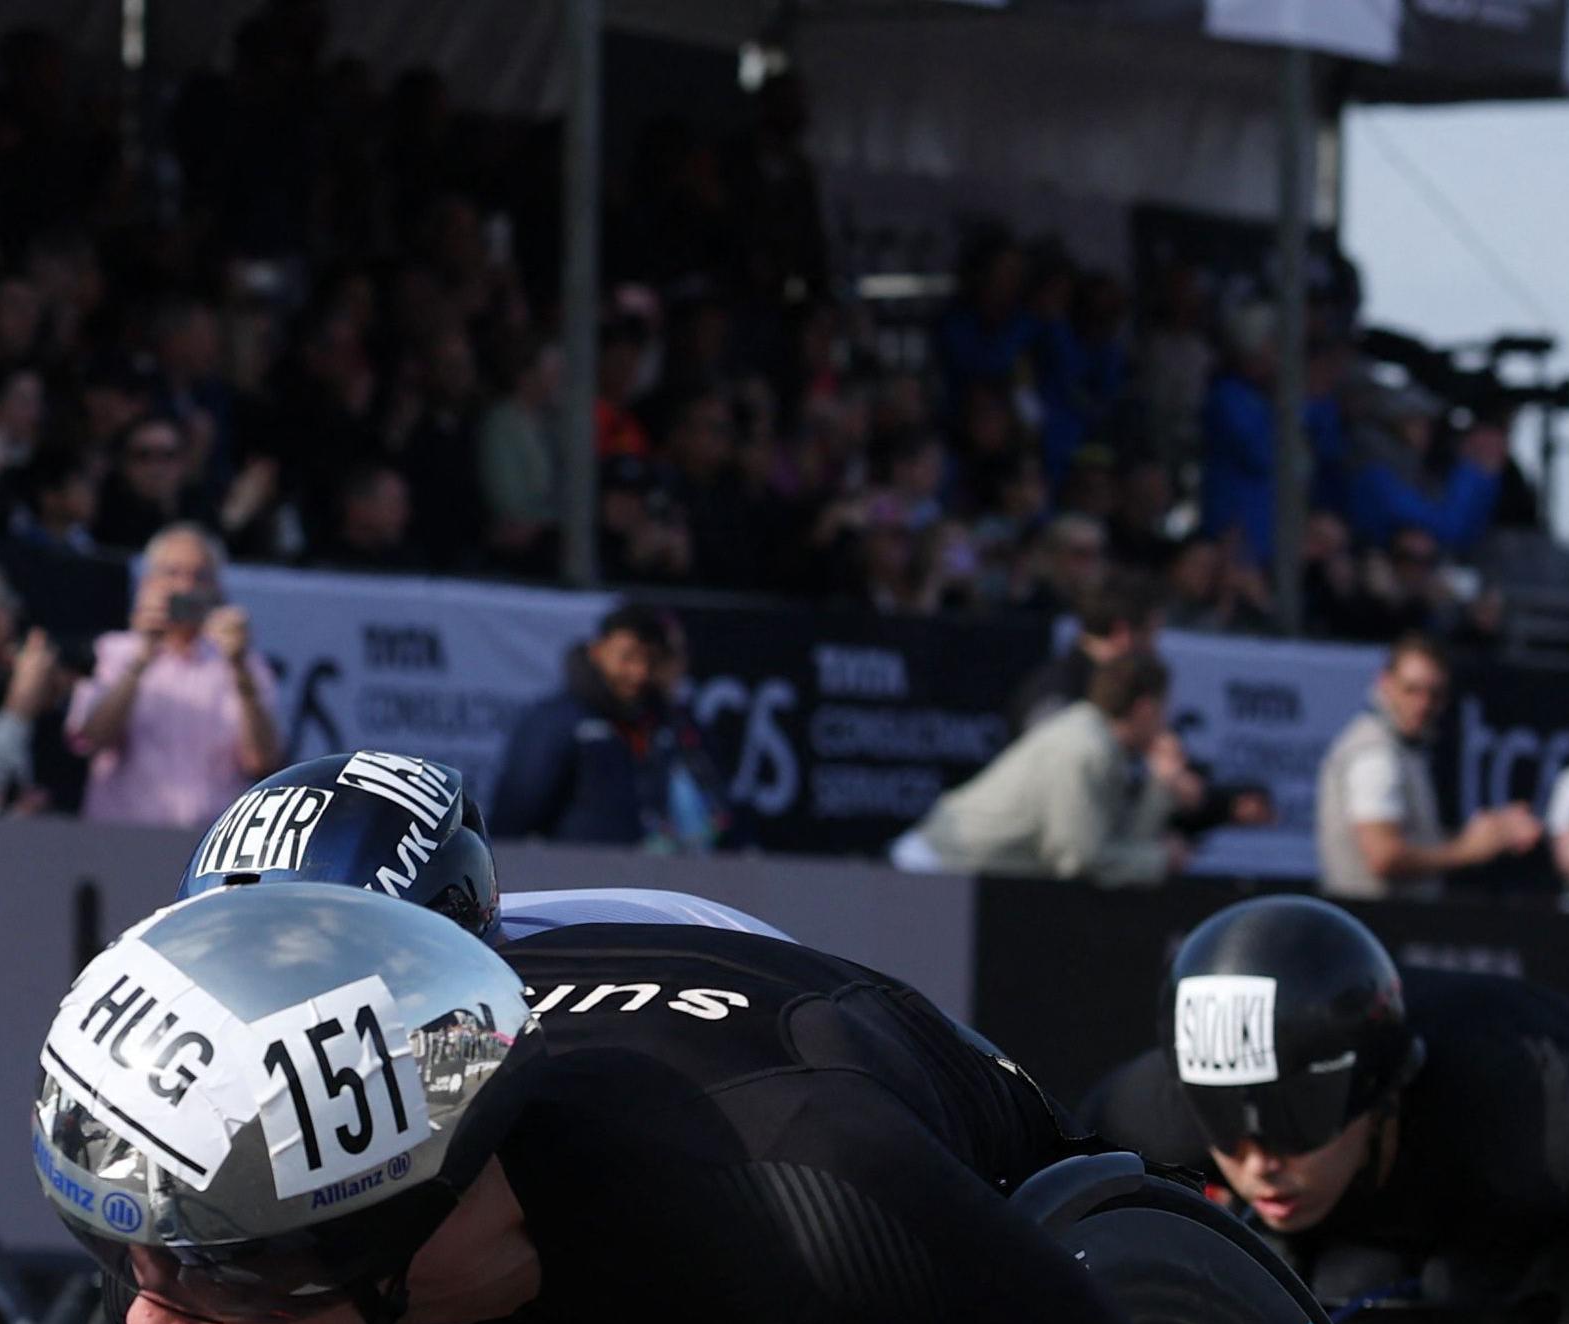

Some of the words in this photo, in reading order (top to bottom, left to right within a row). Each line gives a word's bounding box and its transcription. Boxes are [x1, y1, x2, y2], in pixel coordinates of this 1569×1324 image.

[200, 786, 328, 873] WEIR
[364, 820, 439, 898] ASK
[79, 973, 215, 1107] HUG
[263, 1004, 409, 1172] 151
[310, 1168, 385, 1209] Allianz
